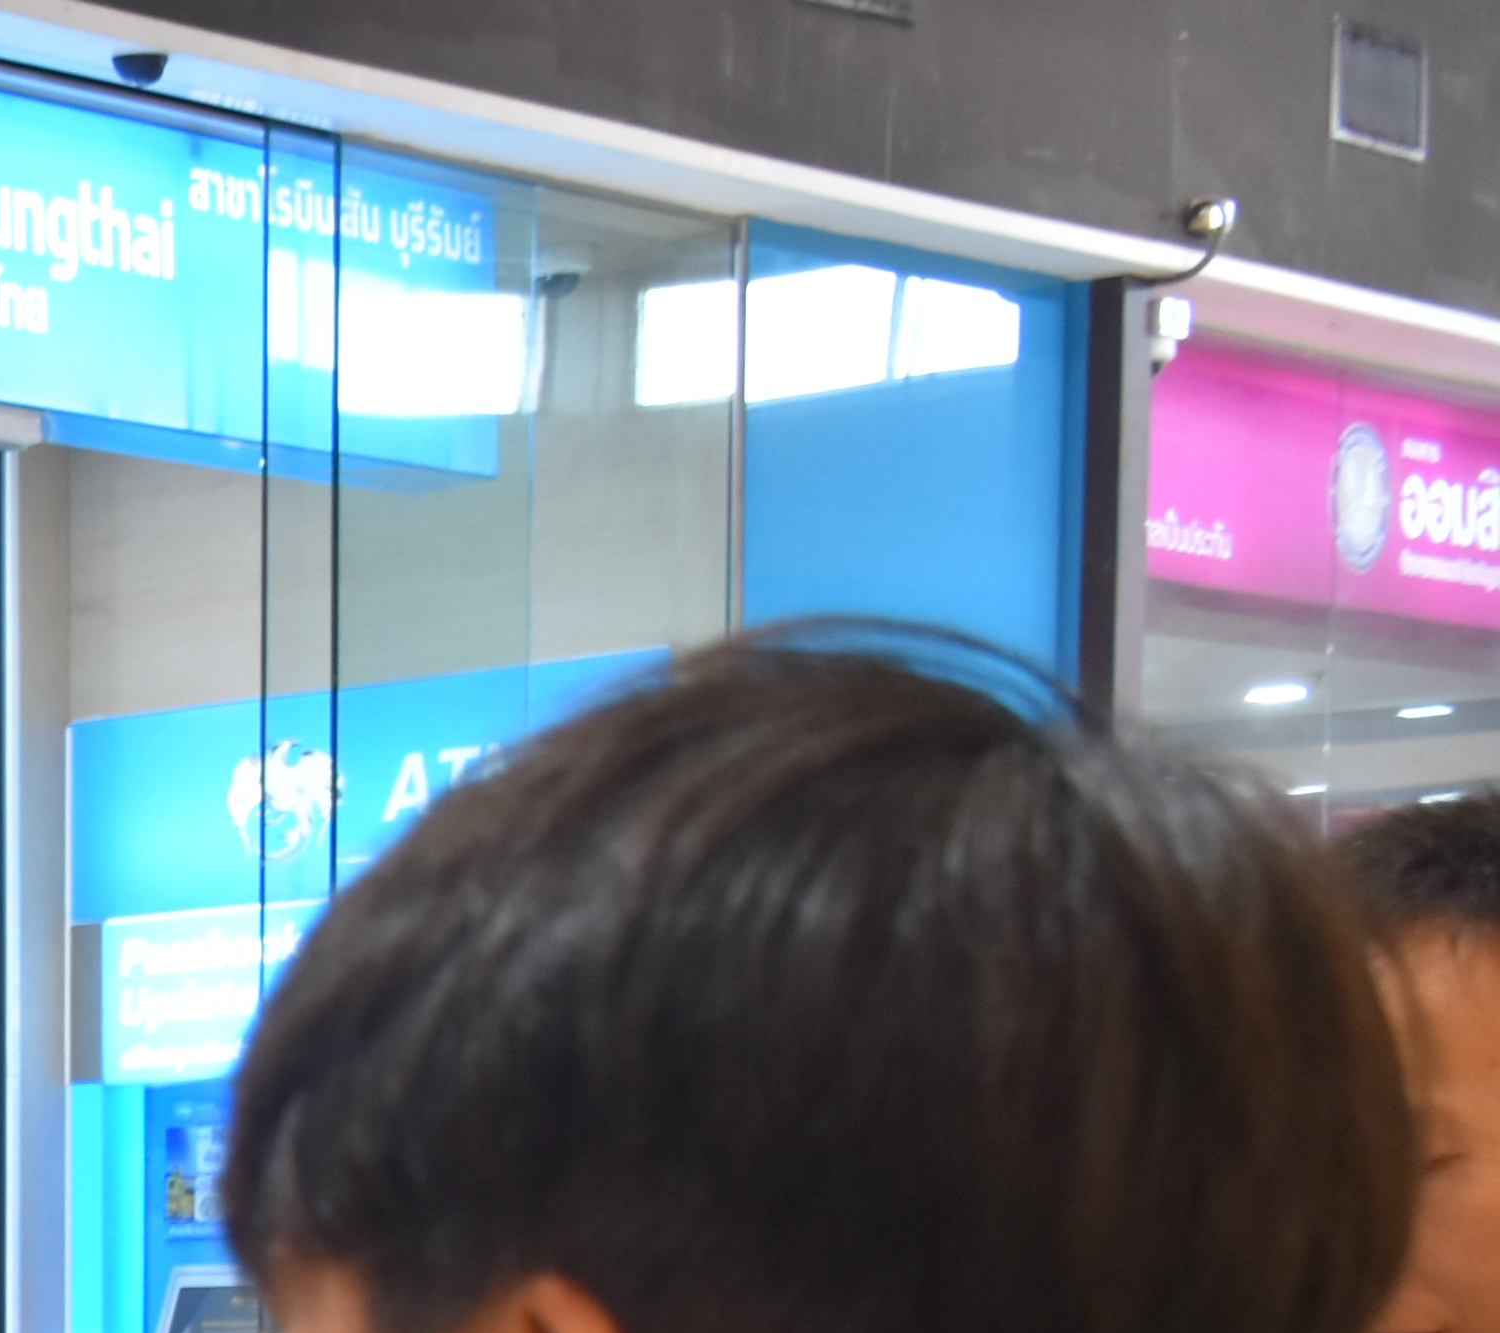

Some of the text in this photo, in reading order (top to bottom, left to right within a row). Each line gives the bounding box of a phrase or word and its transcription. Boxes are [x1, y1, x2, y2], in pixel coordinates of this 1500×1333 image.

[390, 198, 482, 269] บุรีรัมย์
[119, 980, 259, 1034] Update
